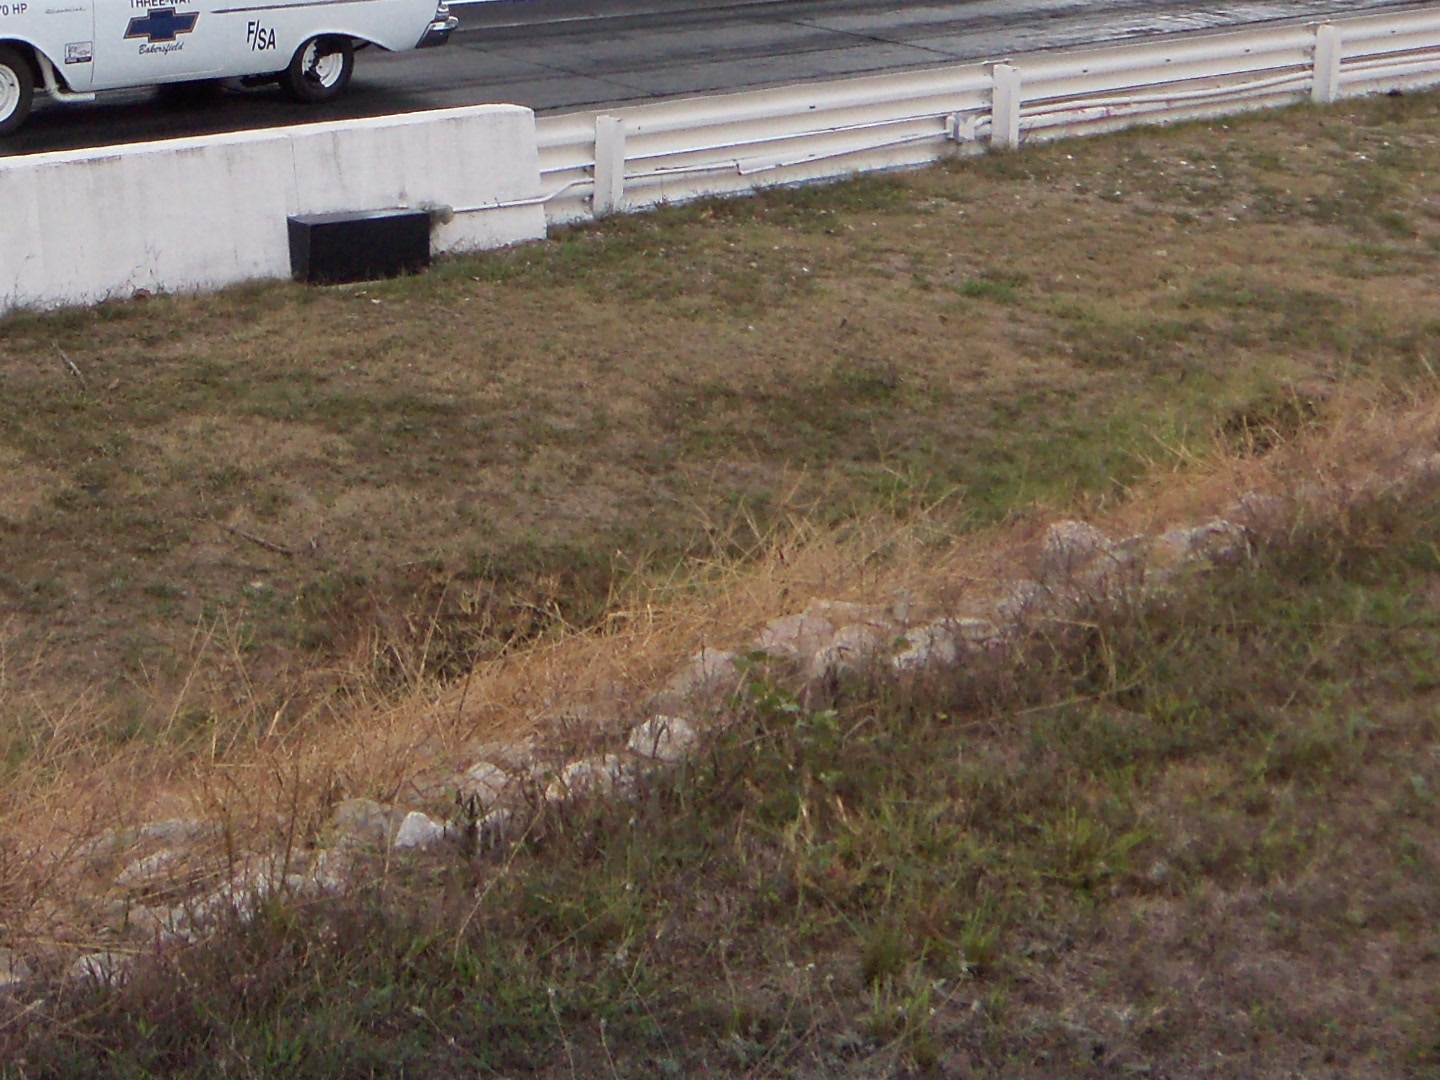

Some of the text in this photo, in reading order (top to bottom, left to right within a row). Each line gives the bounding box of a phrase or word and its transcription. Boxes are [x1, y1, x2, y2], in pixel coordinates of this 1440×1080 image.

[12, 3, 28, 15] HP
[247, 20, 276, 51] F/SA
[138, 42, 185, 55] Bakersfield
